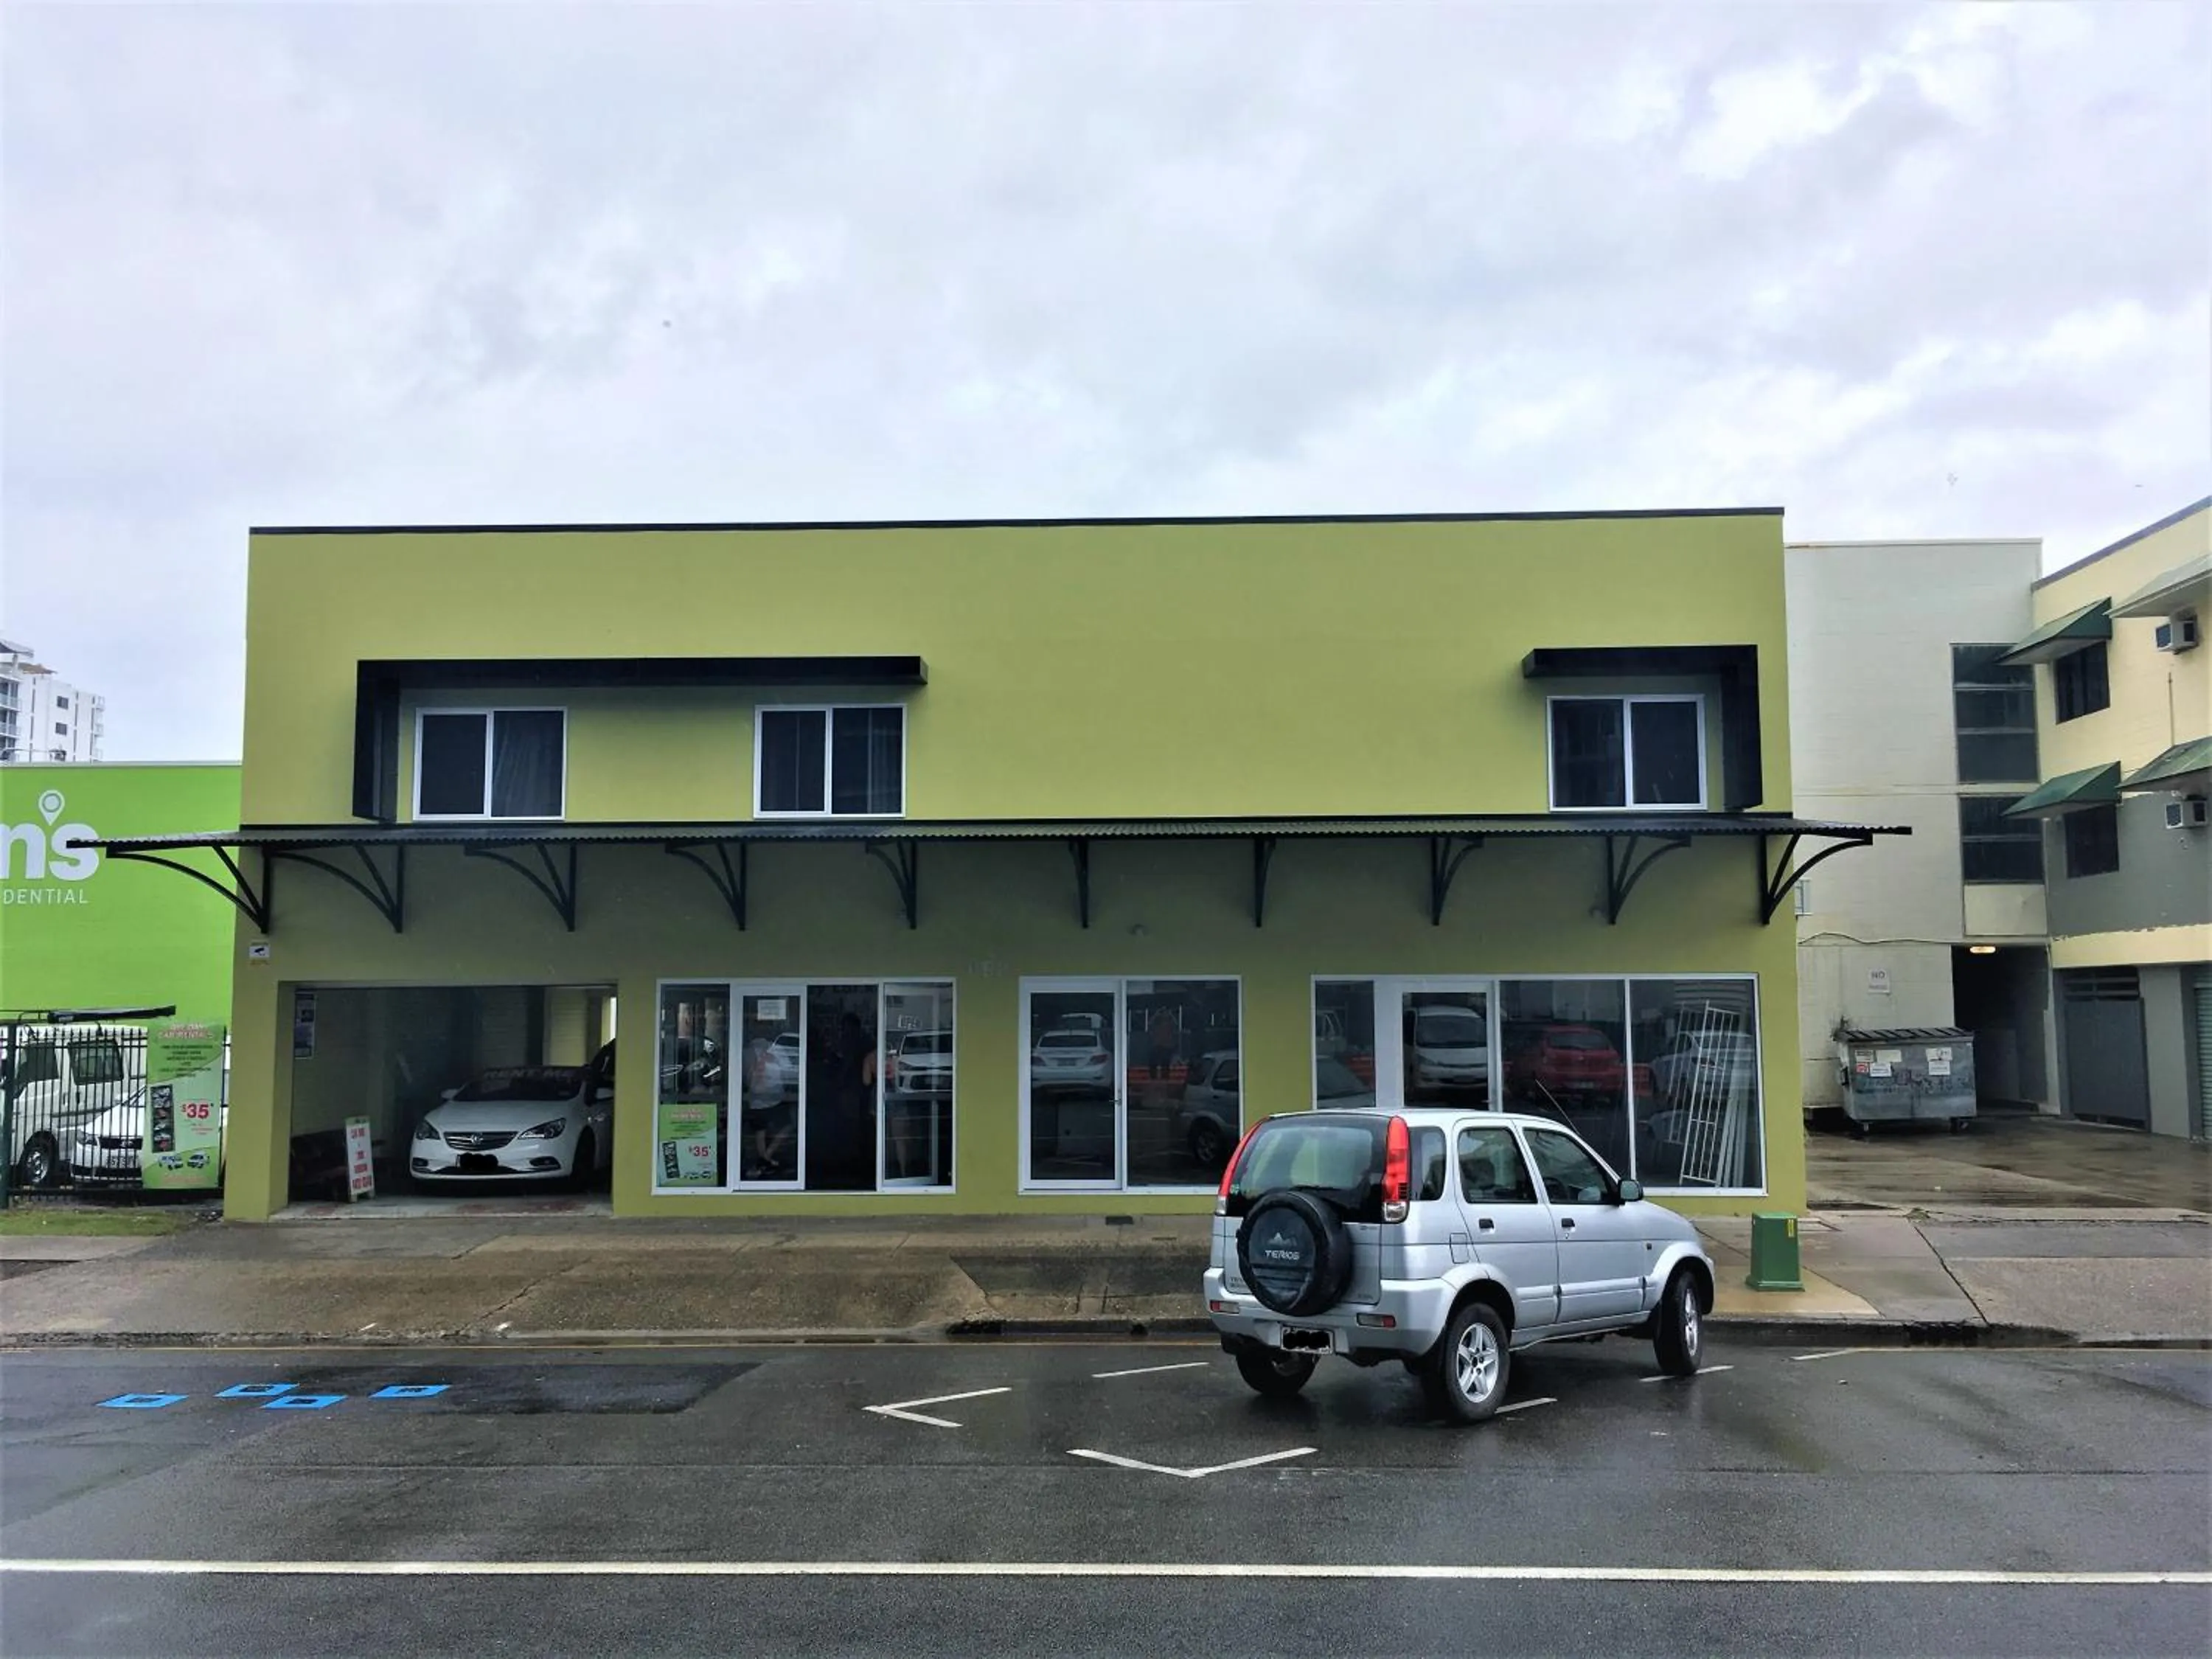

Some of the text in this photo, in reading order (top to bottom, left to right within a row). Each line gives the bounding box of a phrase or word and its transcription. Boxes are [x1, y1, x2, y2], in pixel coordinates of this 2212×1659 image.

[3, 888, 88, 905] DENTIAL
[1871, 970, 1885, 979] NO
[1265, 1250, 1300, 1260] TERIOS
